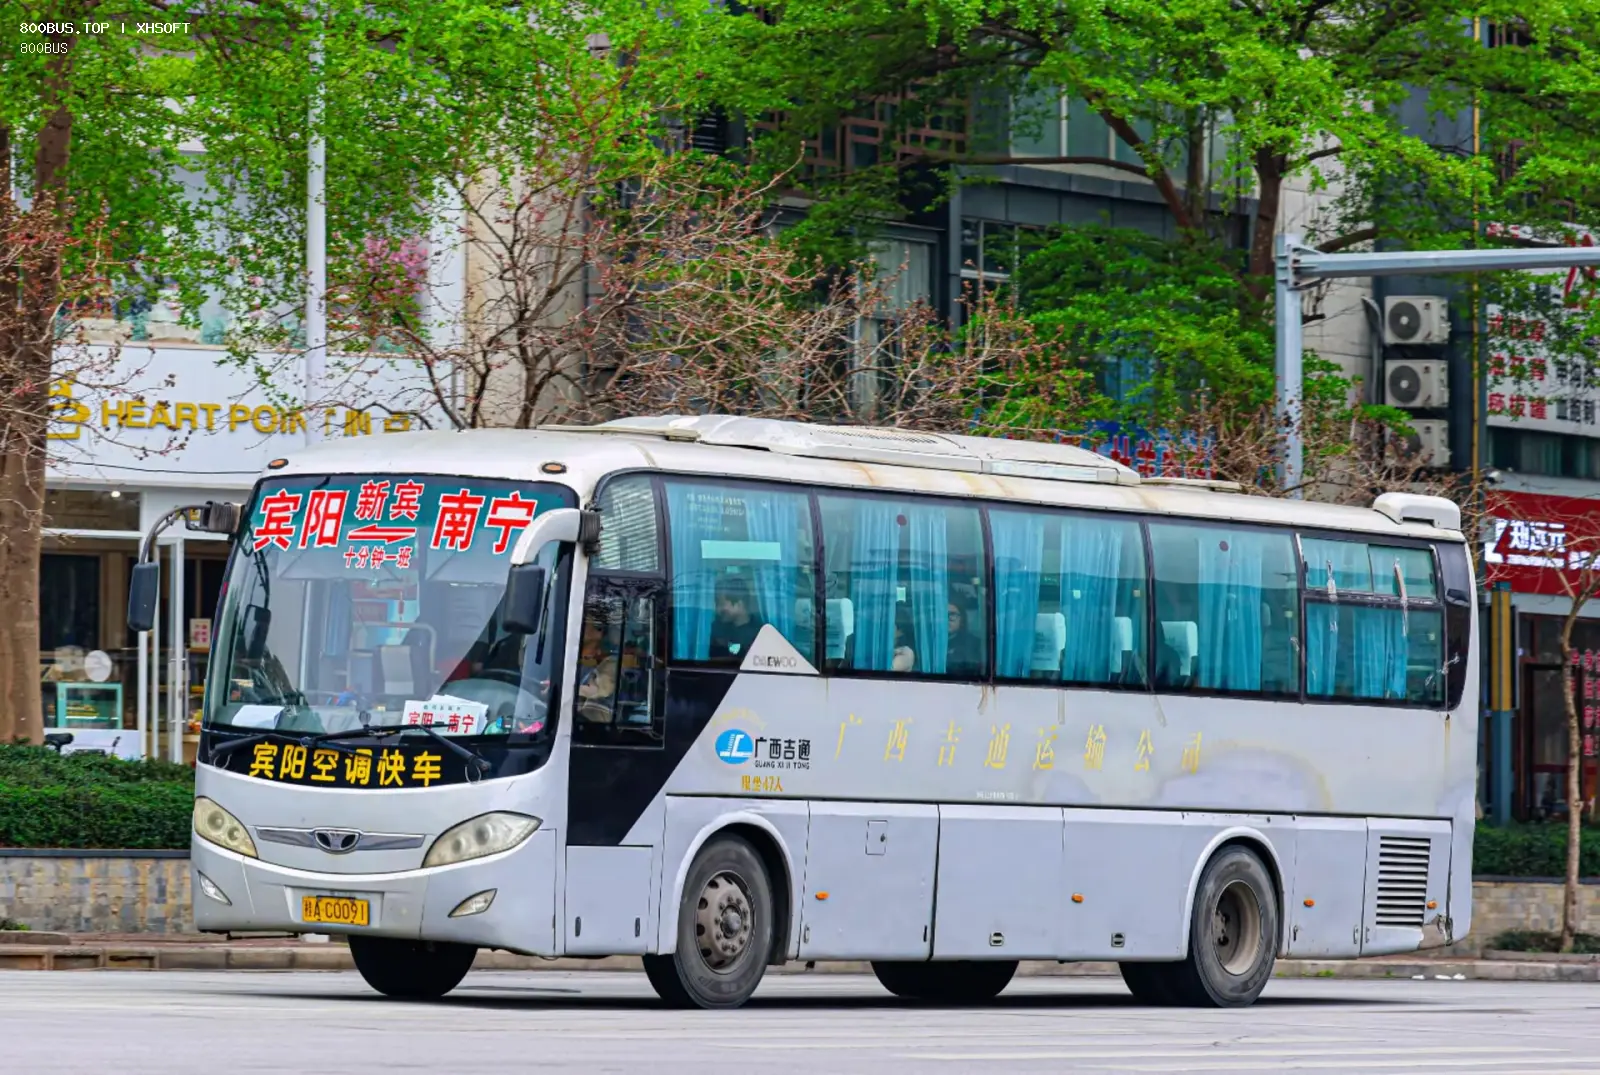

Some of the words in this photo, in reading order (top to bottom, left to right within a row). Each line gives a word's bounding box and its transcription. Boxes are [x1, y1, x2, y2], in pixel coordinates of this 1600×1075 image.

[101, 399, 221, 431] HEART
[354, 479, 424, 521] 新宾
[252, 488, 349, 551] 宾阳
[430, 488, 538, 553] 南宁
[343, 545, 413, 569] 十分钟一班
[447, 711, 474, 734] 南宁
[754, 736, 811, 761] 广西吉通
[249, 741, 442, 787] 宾阳空调快车
[755, 760, 775, 769] GUANG
